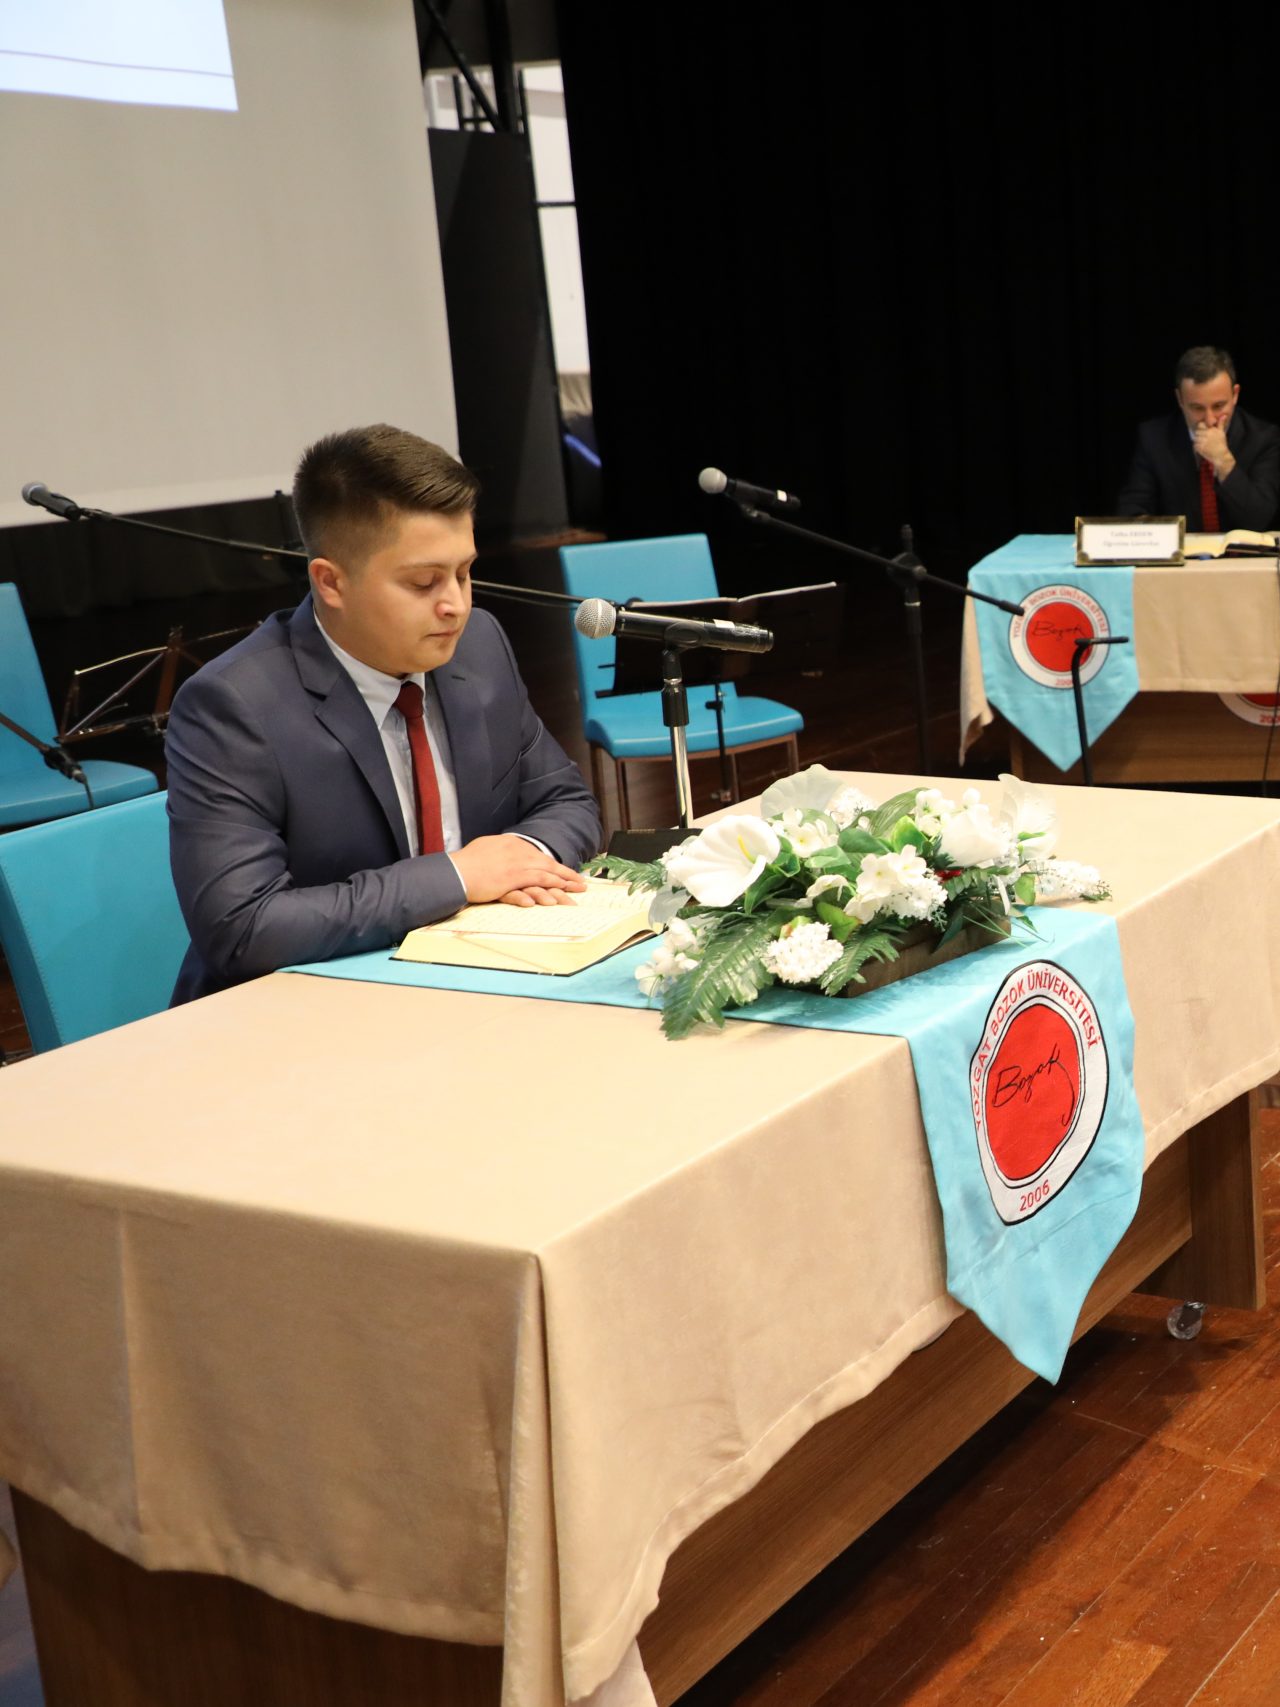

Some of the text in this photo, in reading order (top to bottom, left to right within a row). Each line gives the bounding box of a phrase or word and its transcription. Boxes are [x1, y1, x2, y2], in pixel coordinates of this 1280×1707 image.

[972, 967, 1100, 1131] YOZGAT BOZOK ÜNİVERSİTESİ
[992, 1043, 1076, 1127] Bozok
[1019, 1179, 1051, 1212] 2006
